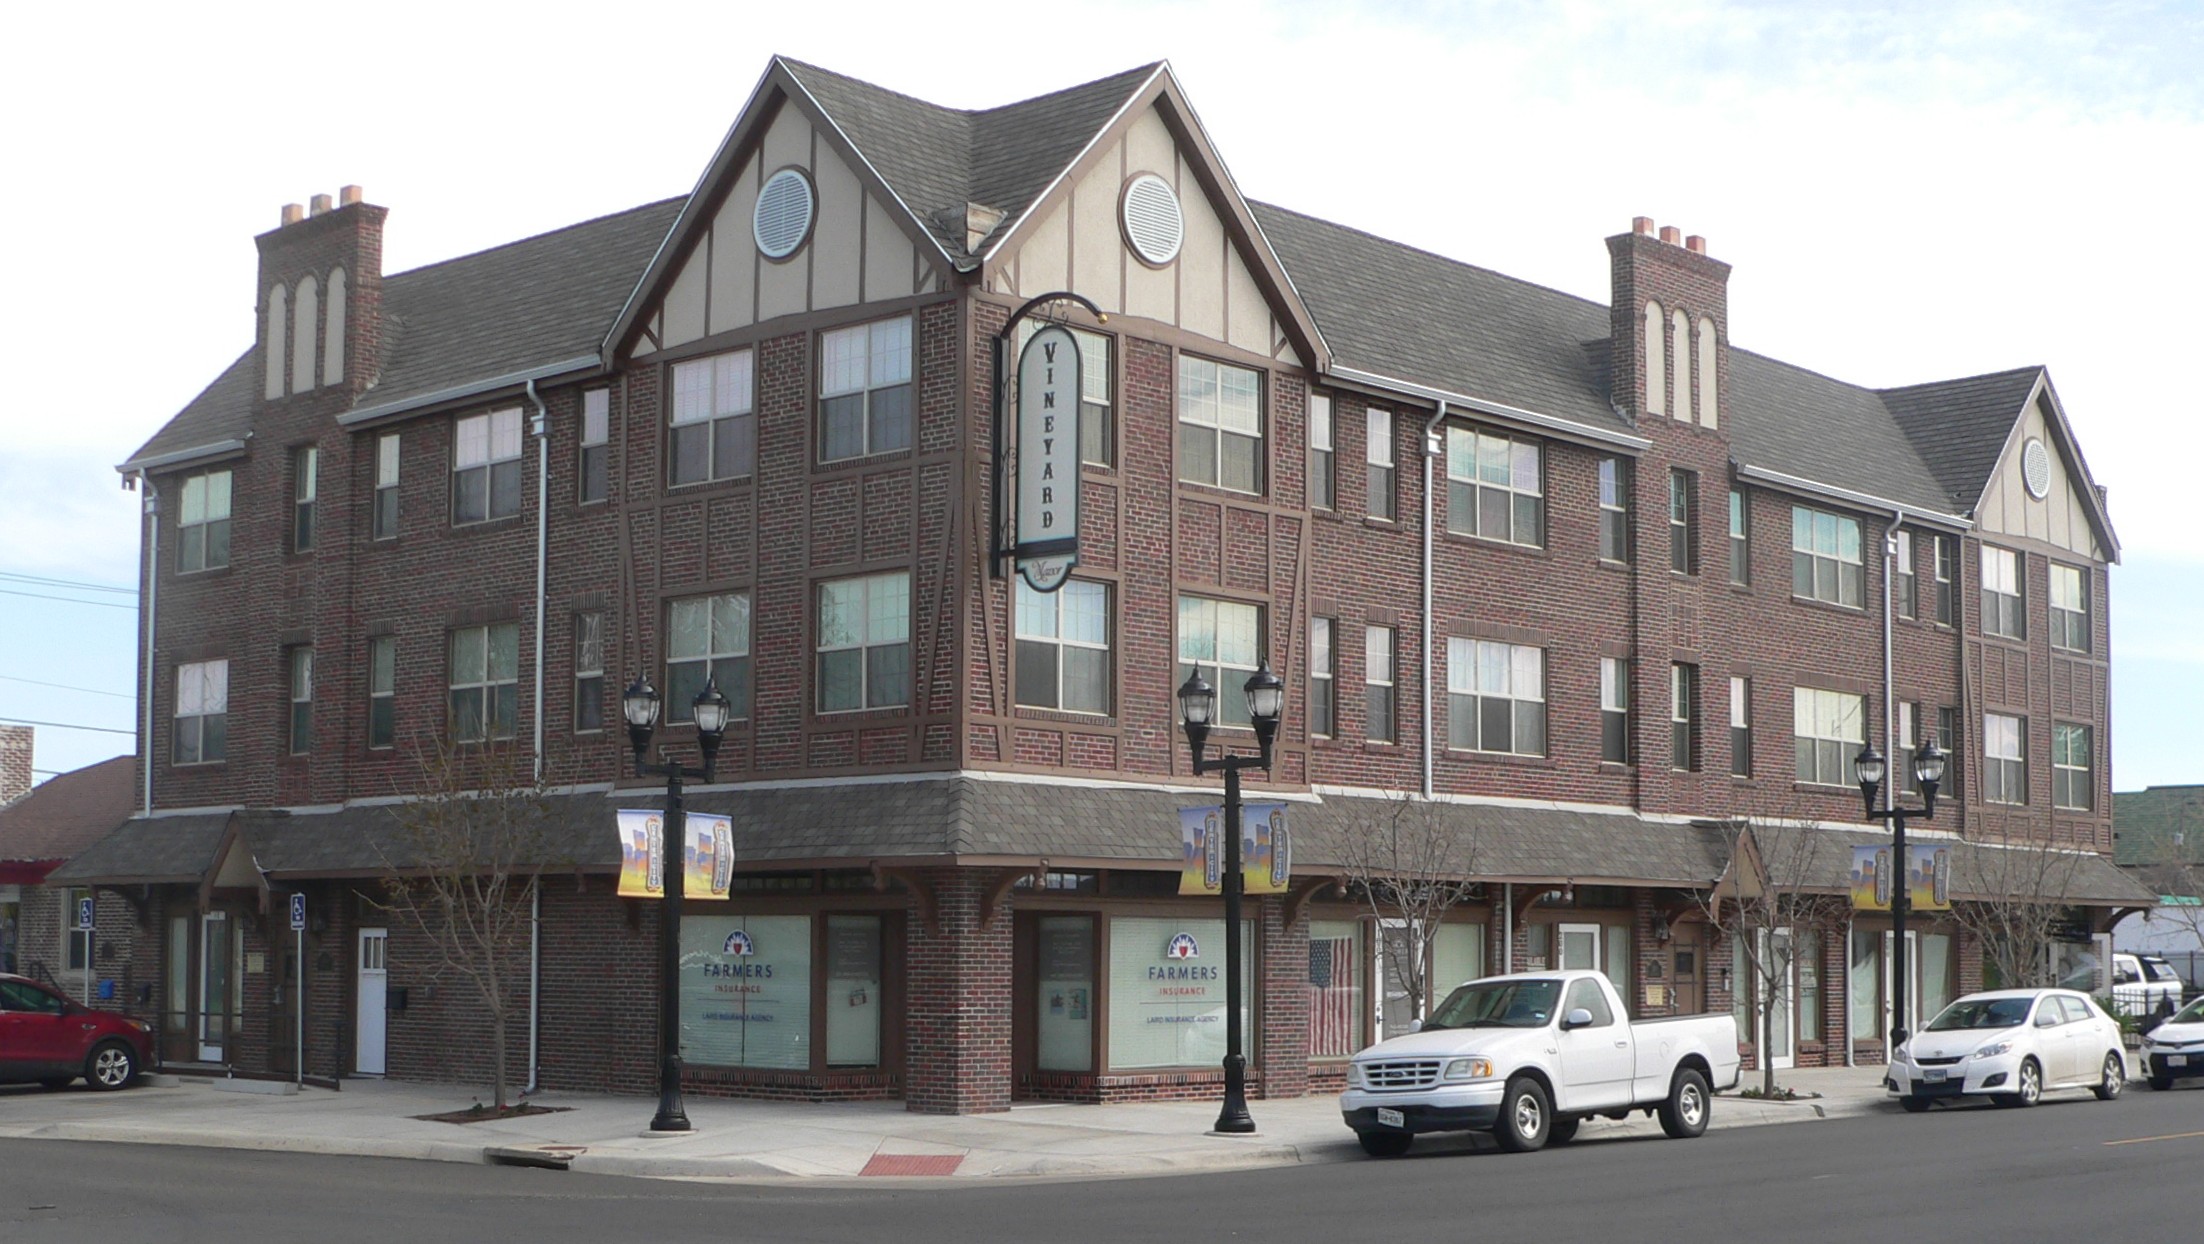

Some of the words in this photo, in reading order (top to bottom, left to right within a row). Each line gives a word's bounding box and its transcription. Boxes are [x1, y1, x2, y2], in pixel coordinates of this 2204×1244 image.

[1041, 342, 1058, 529] VINEYARD
[704, 964, 773, 978] FARMERS
[1148, 966, 1218, 980] FARMERS
[714, 984, 761, 993] INSURANCE
[1159, 987, 1206, 996] INSURANCE
